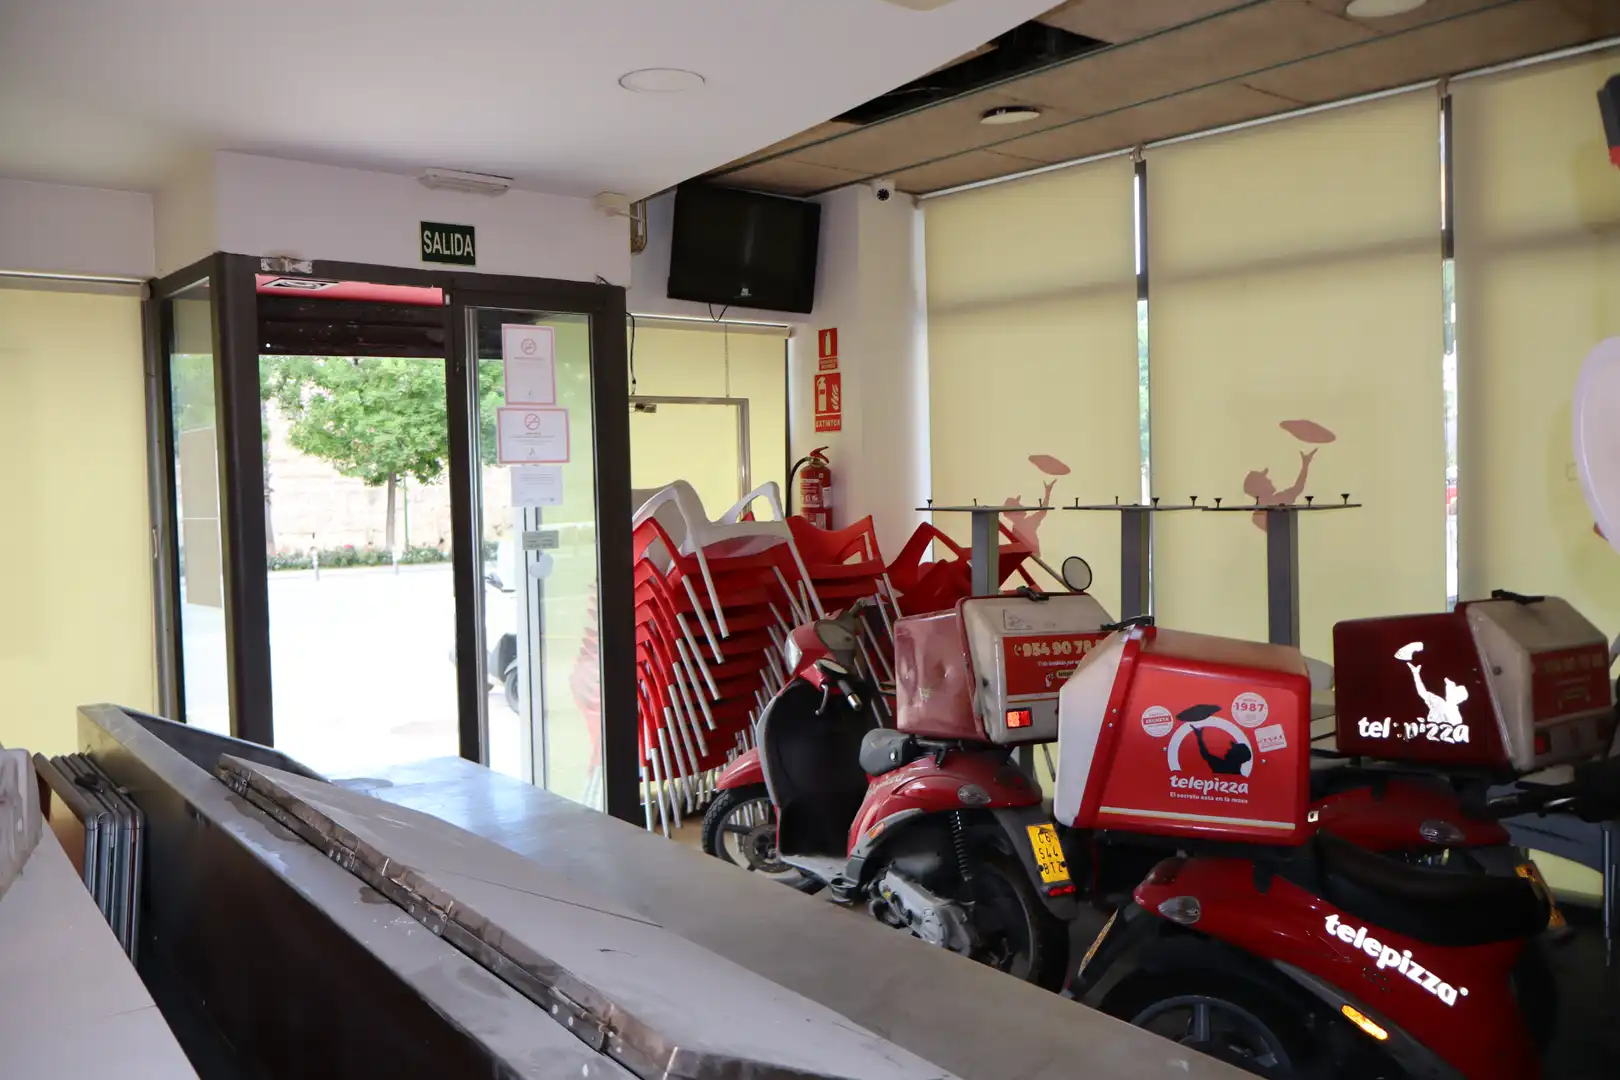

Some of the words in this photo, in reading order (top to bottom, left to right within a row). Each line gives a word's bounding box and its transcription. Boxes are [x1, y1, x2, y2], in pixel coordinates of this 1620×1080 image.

[423, 230, 474, 257] SALIDA
[1022, 642, 1050, 657] 954
[1052, 641, 1072, 655] 90
[1235, 702, 1265, 712] 1987
[1358, 717, 1469, 743] telpizza
[1170, 775, 1248, 795] telepizza
[1325, 914, 1457, 1006] telepizza
